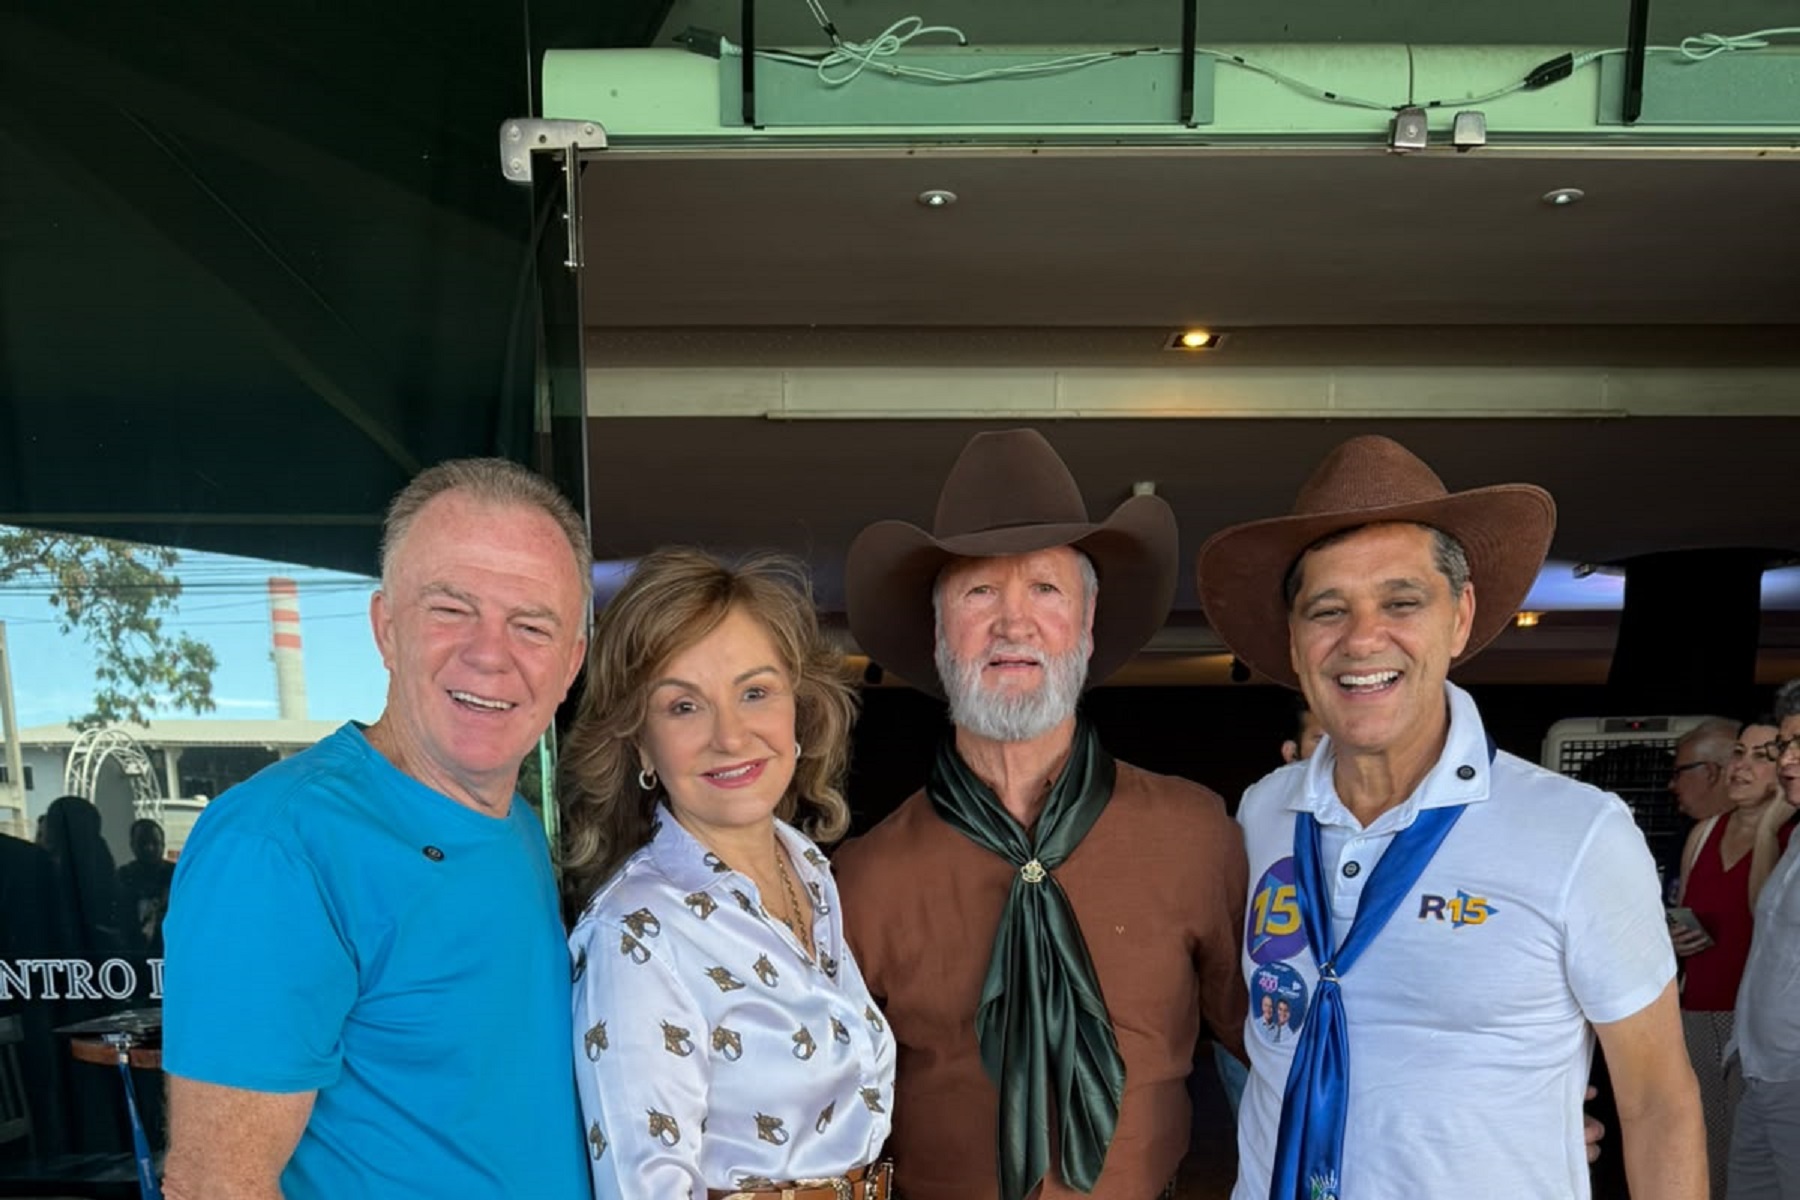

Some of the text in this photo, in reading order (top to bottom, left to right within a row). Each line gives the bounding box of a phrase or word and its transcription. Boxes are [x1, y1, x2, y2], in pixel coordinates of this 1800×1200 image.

[1253, 884, 1302, 937] 15
[1418, 893, 1489, 925] R15
[0, 958, 138, 1000] NTRO
